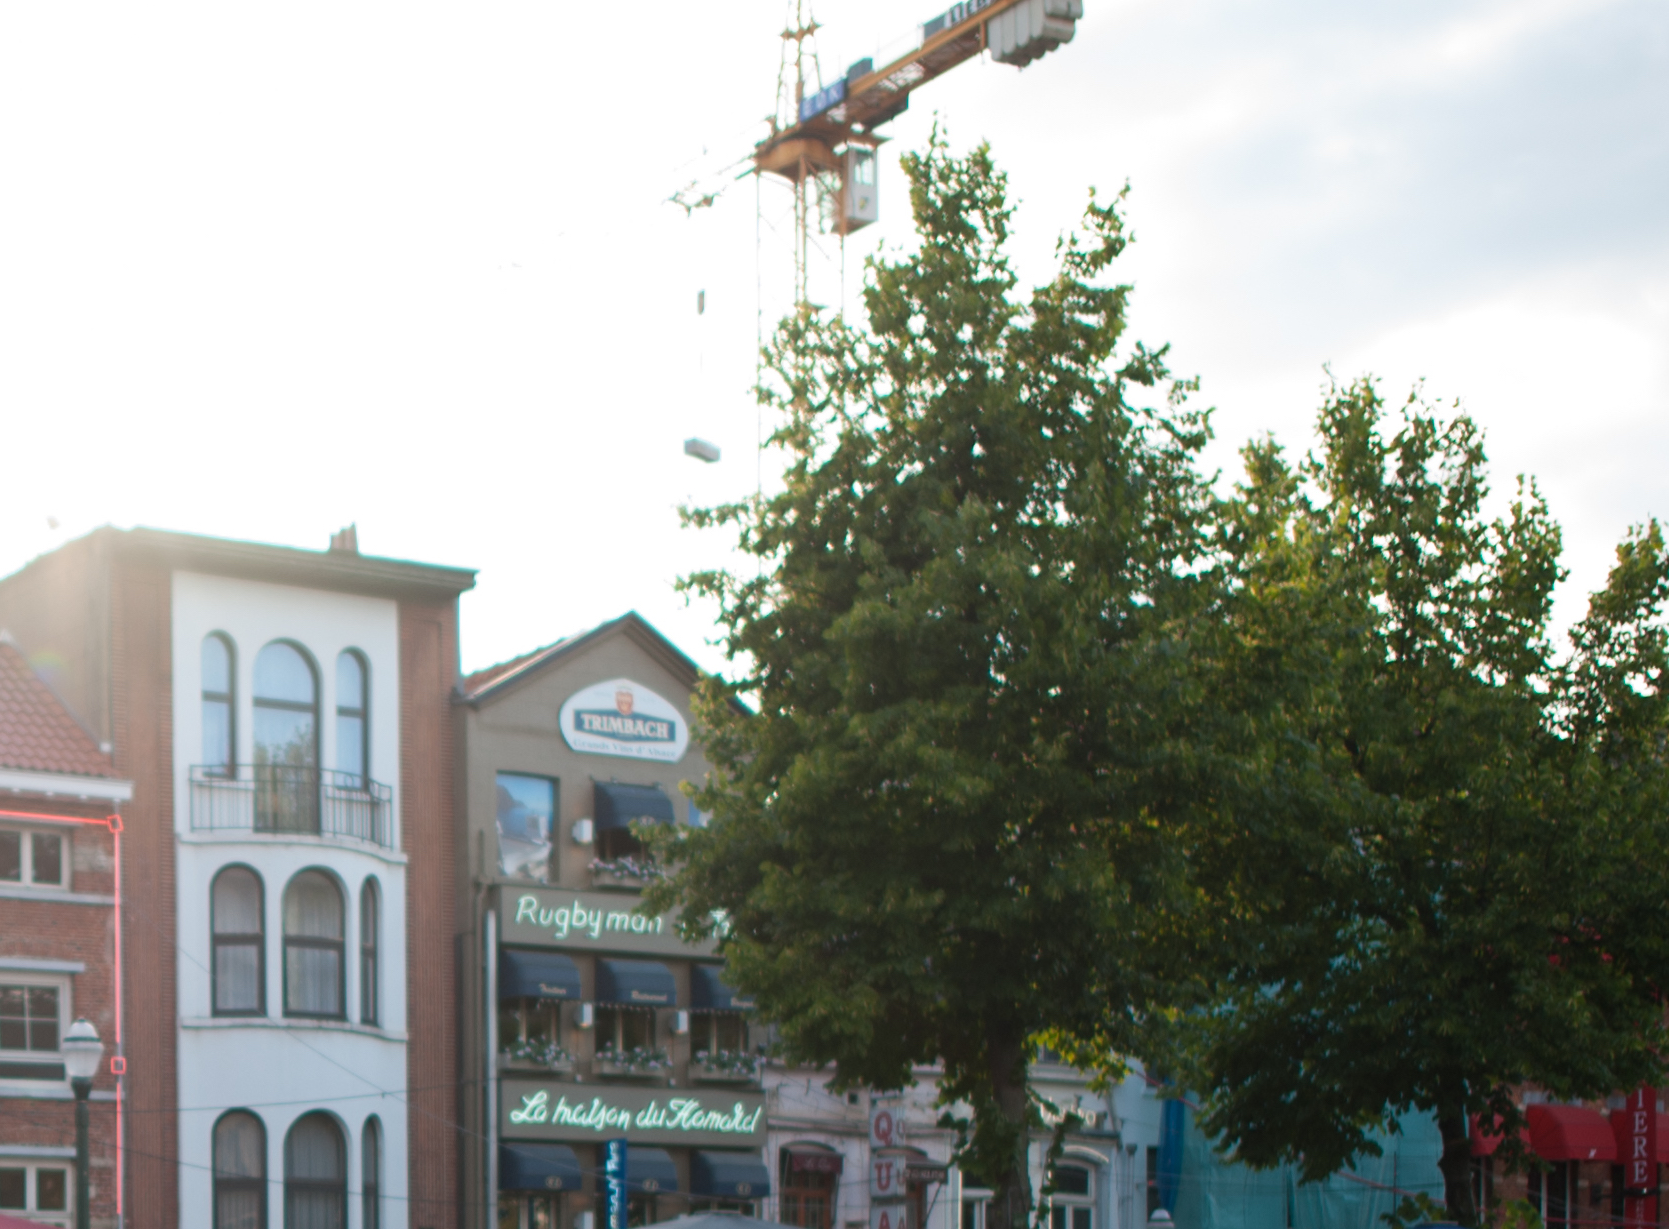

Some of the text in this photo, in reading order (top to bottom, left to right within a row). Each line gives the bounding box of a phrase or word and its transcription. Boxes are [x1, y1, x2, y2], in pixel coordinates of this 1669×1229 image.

[581, 713, 670, 739] TRIMBACH
[515, 893, 664, 940] Rugbyman
[510, 1088, 549, 1124] La
[634, 1098, 666, 1128] du
[666, 1097, 762, 1134] Homard
